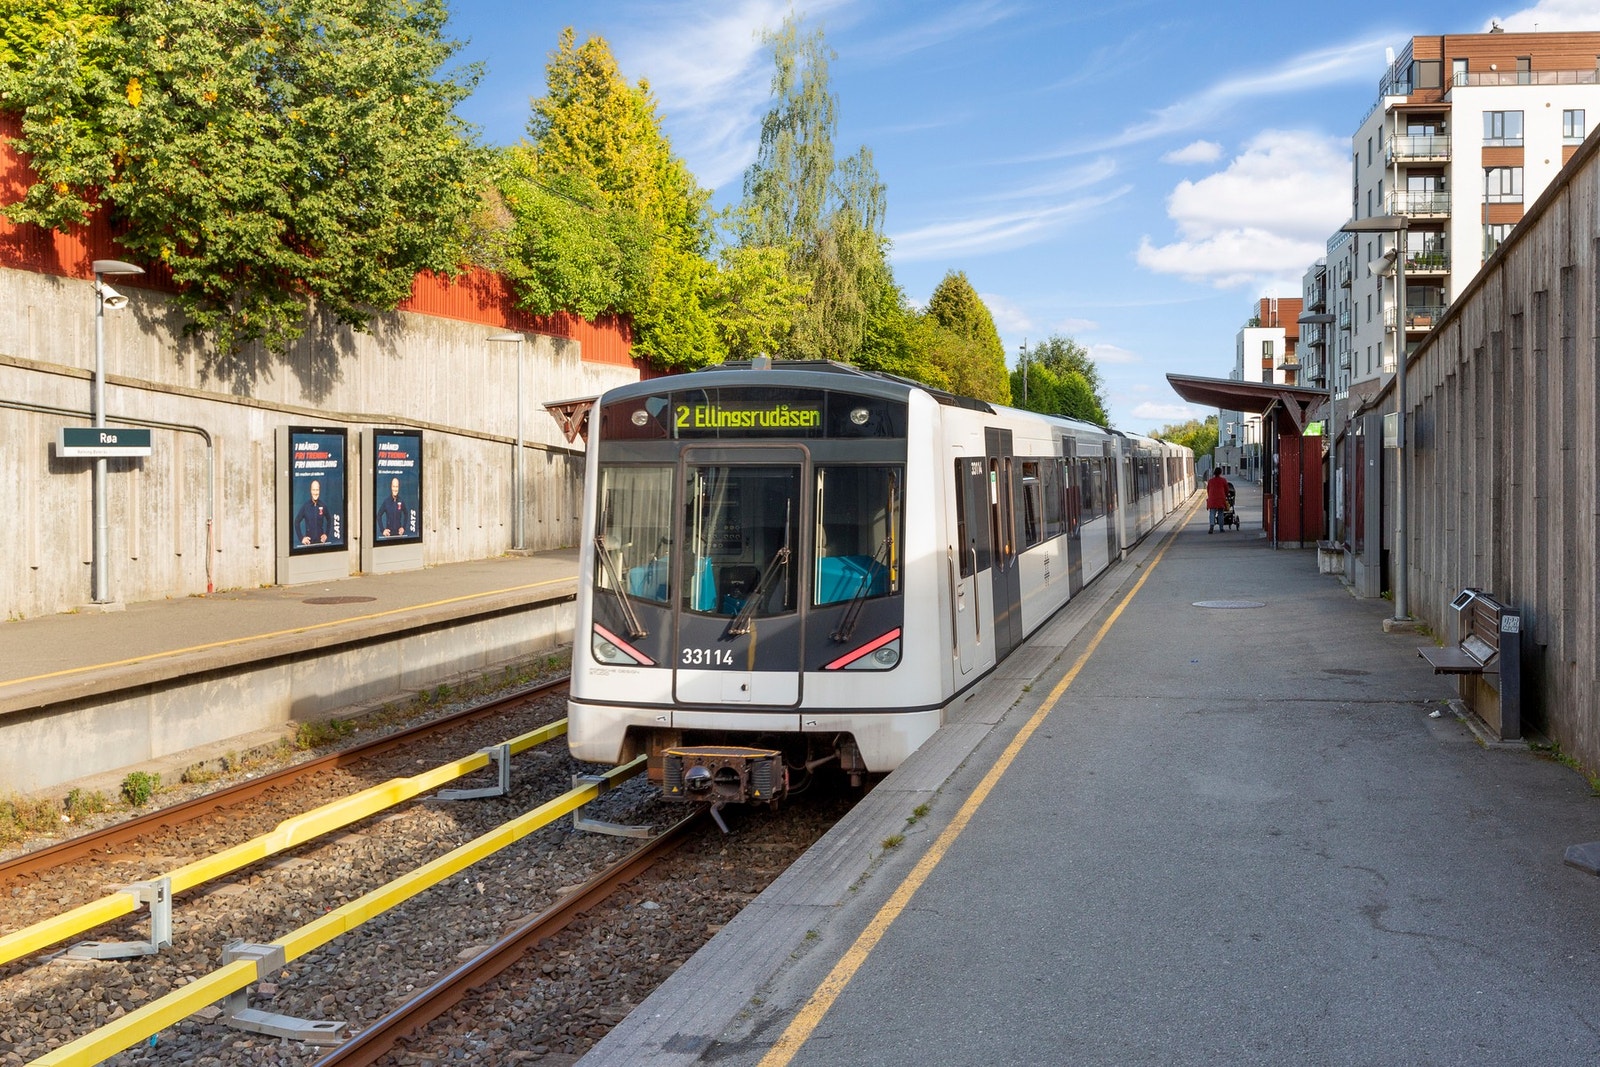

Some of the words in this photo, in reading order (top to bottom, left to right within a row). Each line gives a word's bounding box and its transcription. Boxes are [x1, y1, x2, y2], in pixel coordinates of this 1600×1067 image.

[676, 405, 690, 428] 2
[695, 404, 821, 427] Ellingsrudåsen
[99, 432, 118, 444] Røa
[682, 648, 734, 666] 33114
